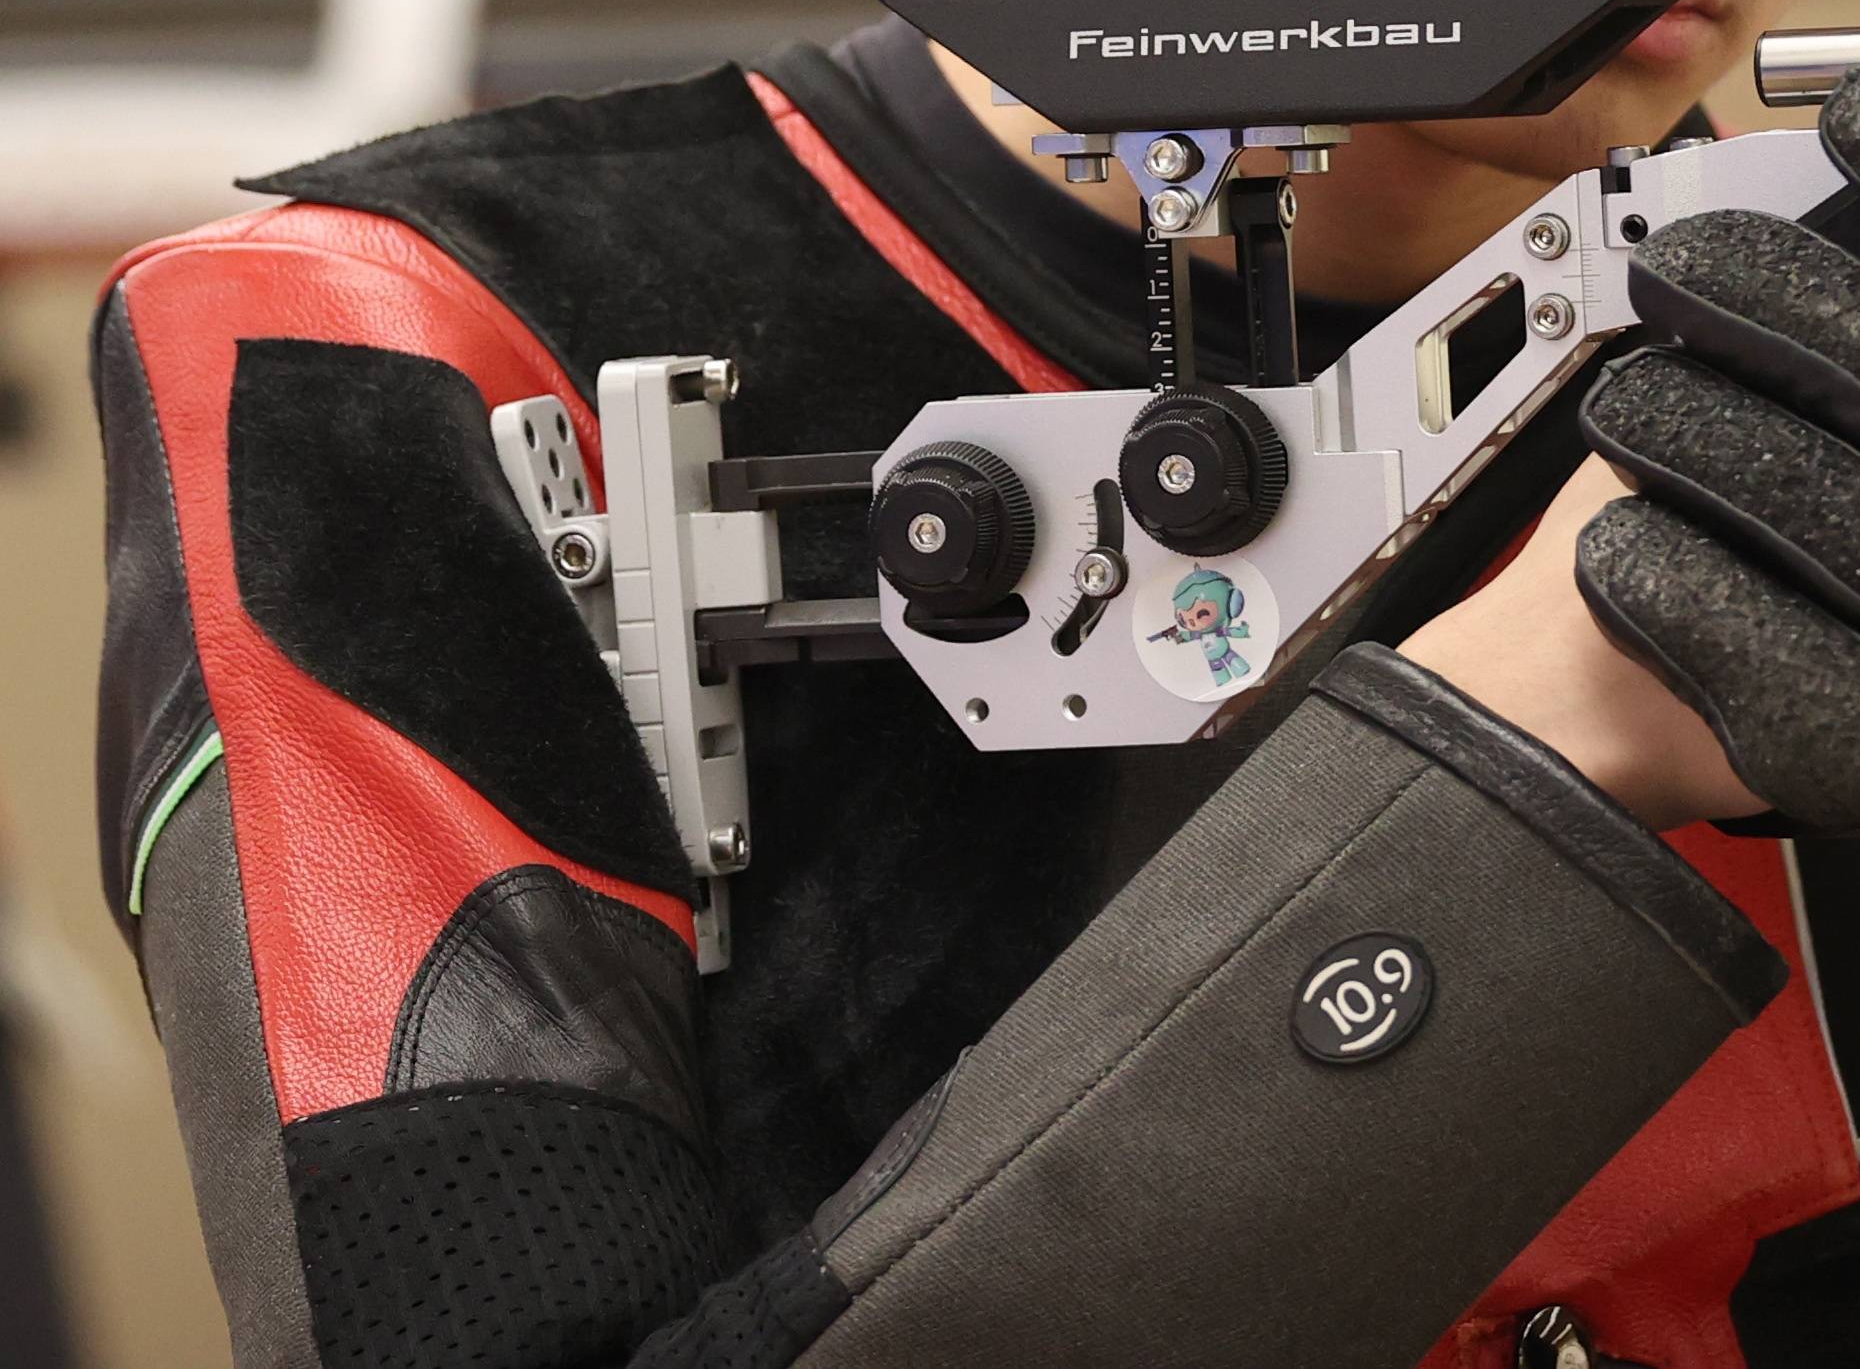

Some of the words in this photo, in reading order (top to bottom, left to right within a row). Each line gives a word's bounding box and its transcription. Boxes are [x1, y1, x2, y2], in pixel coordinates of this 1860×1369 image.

[1069, 18, 1461, 60] Feinwerkbau
[1151, 331, 1163, 347] 2
[1320, 948, 1413, 1035] 10.9
